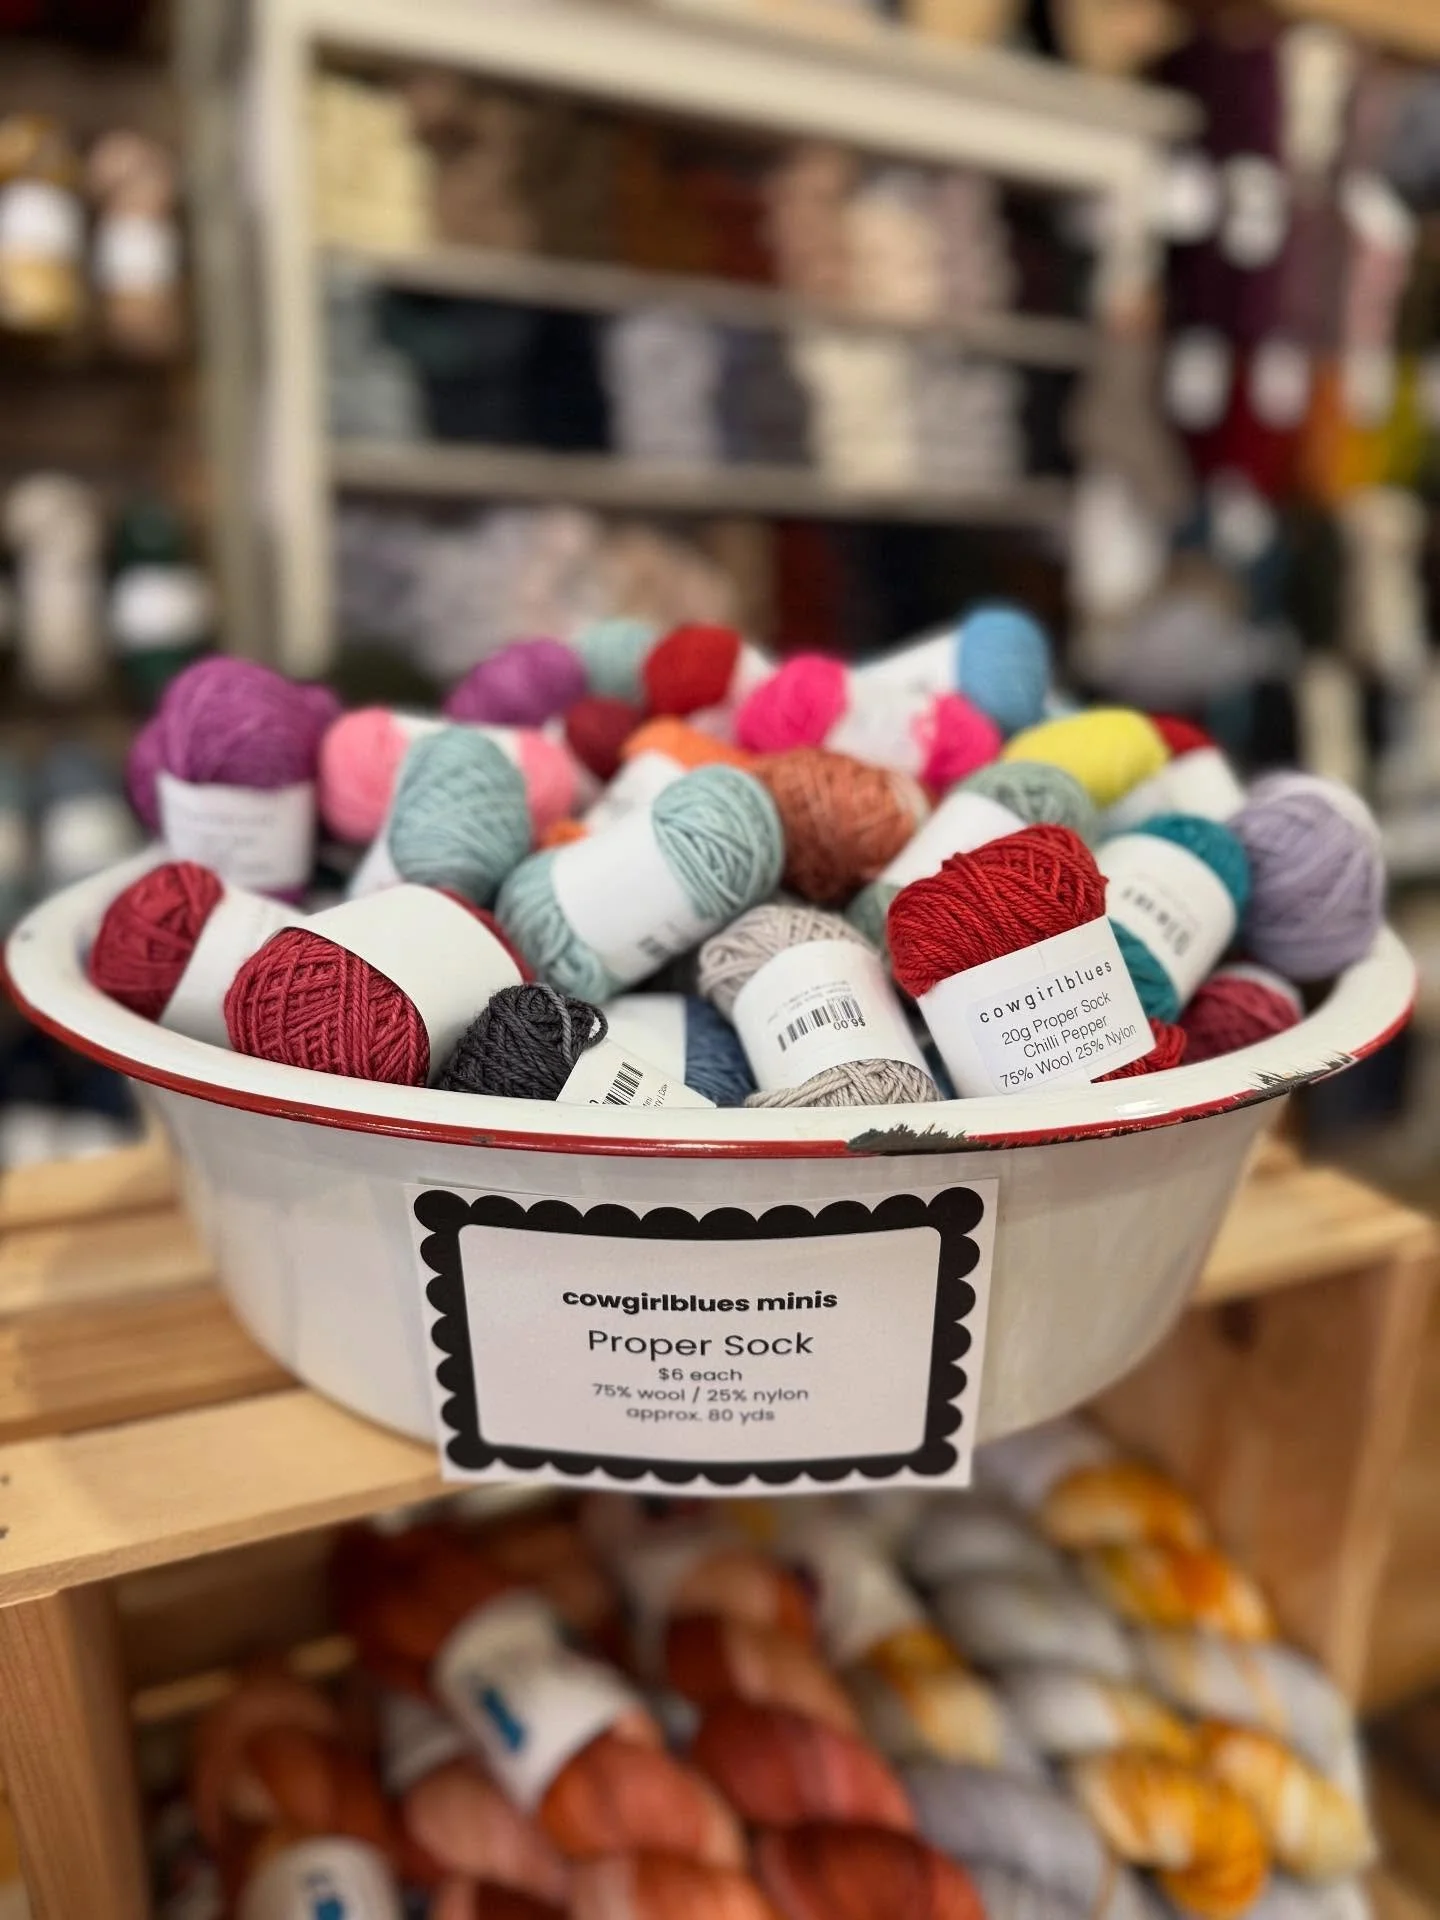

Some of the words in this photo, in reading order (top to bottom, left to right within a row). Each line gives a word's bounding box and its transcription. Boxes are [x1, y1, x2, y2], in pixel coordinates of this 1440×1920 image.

[979, 960, 1112, 1024] cowgirlblues
[833, 1016, 866, 1031] $6.00
[1001, 1025, 1032, 1045] 20g
[1032, 1005, 1078, 1034] Proper
[1082, 992, 1111, 1013] Sock
[1023, 1034, 1059, 1058] Chilli
[1061, 1015, 1108, 1043] Pepper
[1000, 1067, 1034, 1088] 75%
[1035, 1051, 1074, 1076] Wool
[1076, 1040, 1104, 1060] 25%
[1105, 1023, 1137, 1047] Nylon
[562, 1291, 750, 1315] cowgirlblues
[757, 1290, 838, 1312] minis
[588, 1329, 712, 1361] Proper
[724, 1332, 814, 1356] Sock
[658, 1367, 684, 1382] $6
[690, 1368, 742, 1382] each
[592, 1383, 632, 1399] 75%
[637, 1388, 685, 1401] wool
[692, 1386, 700, 1404] /
[707, 1388, 747, 1402] 25%
[753, 1388, 809, 1404] nylon
[626, 1407, 702, 1423] approx.
[708, 1408, 733, 1422] 80
[739, 1408, 775, 1426] yds
